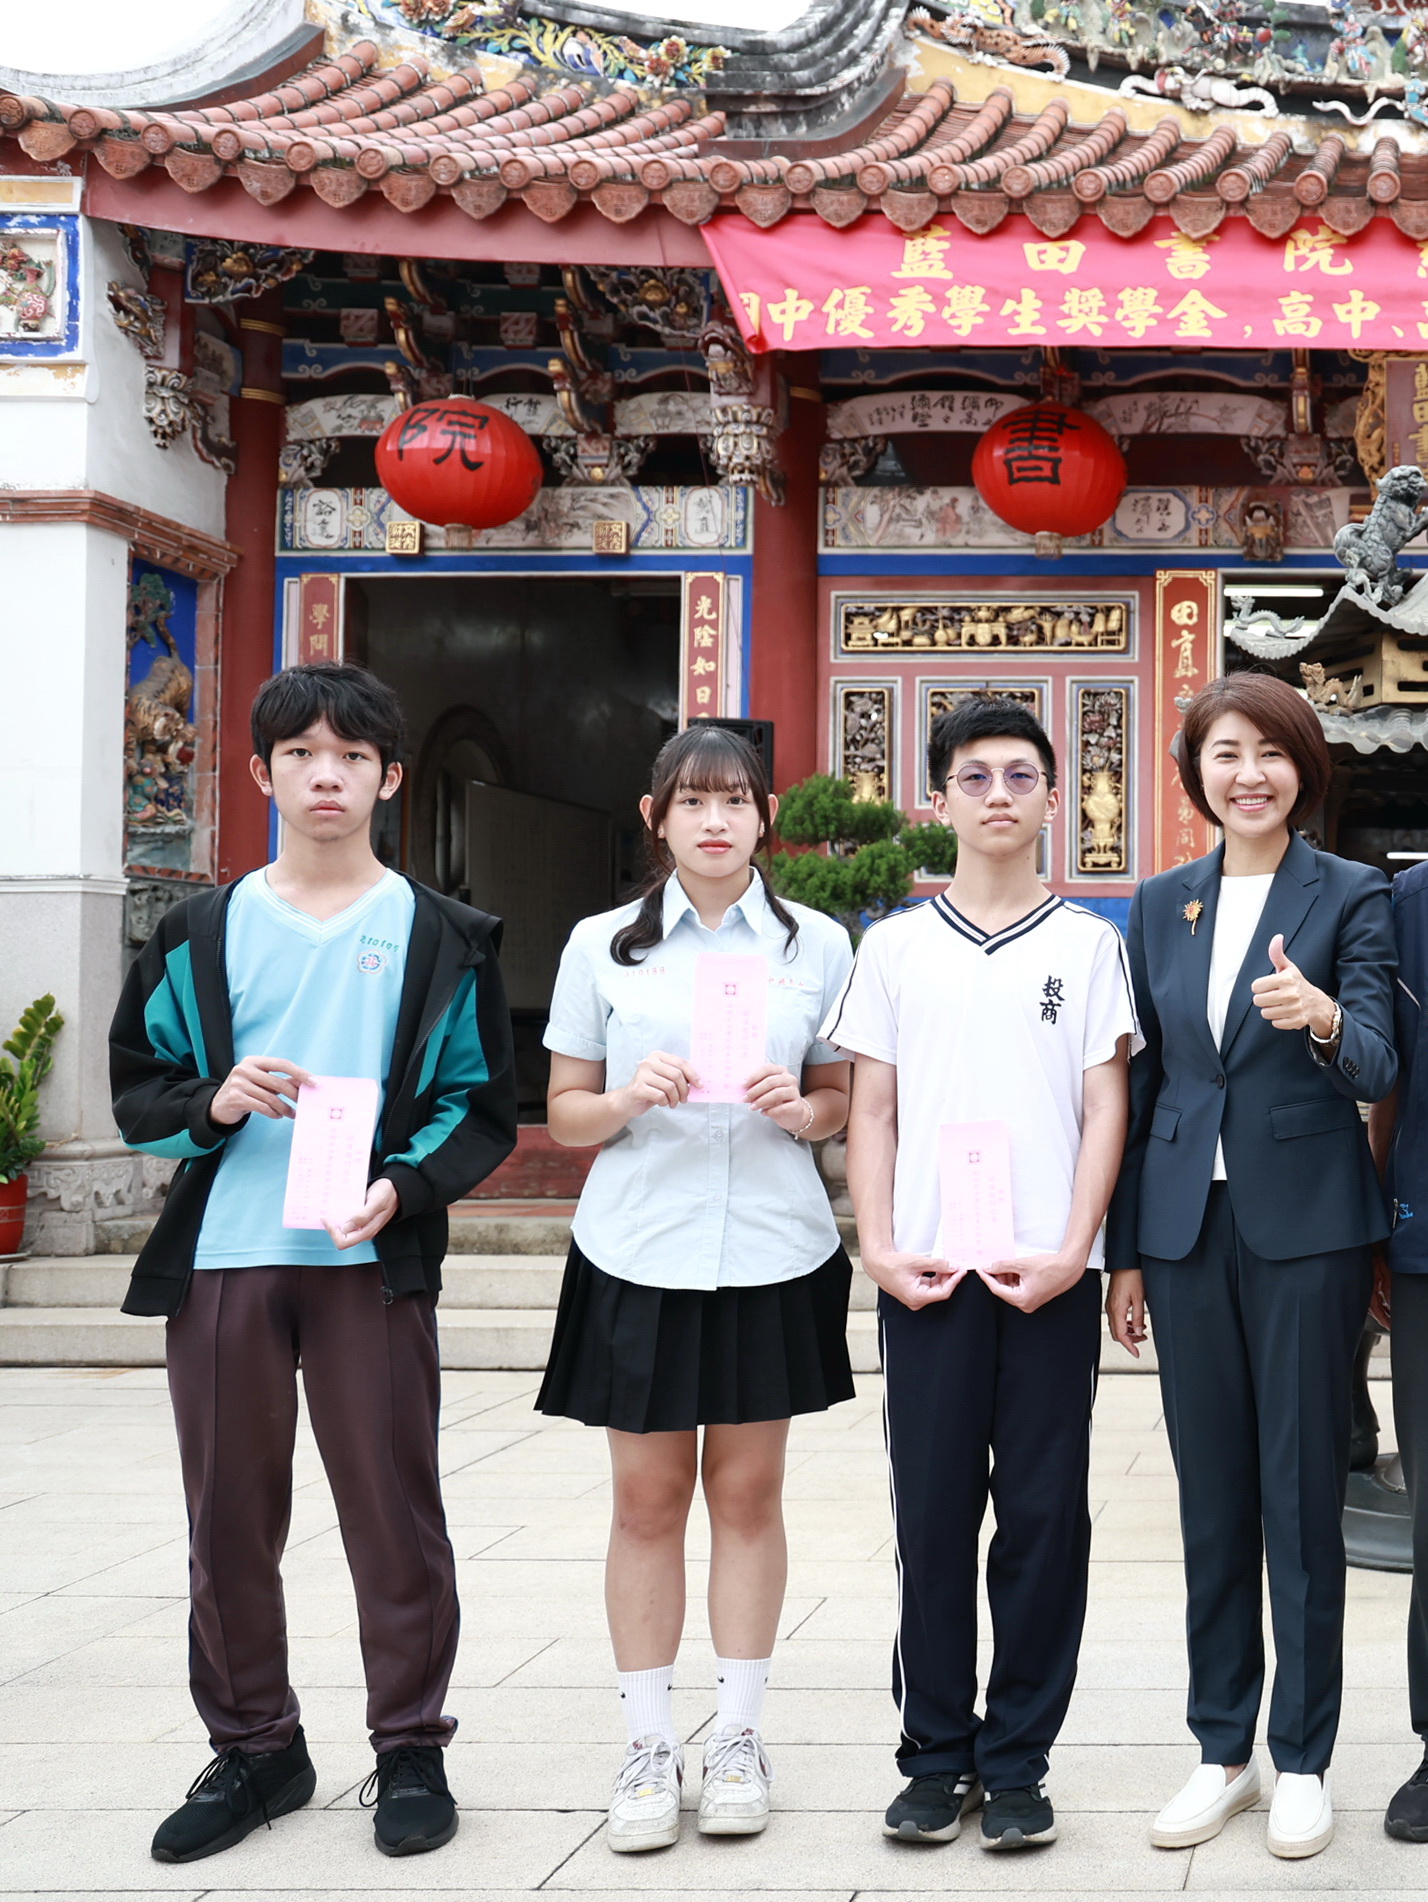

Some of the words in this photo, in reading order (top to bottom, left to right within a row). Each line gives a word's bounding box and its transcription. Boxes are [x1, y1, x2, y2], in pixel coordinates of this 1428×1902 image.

[398, 406, 491, 471] 院
[1002, 408, 1081, 487] 書
[308, 603, 330, 657] 學問
[690, 594, 718, 718] 光陰如日
[1038, 974, 1065, 1026] 投商
